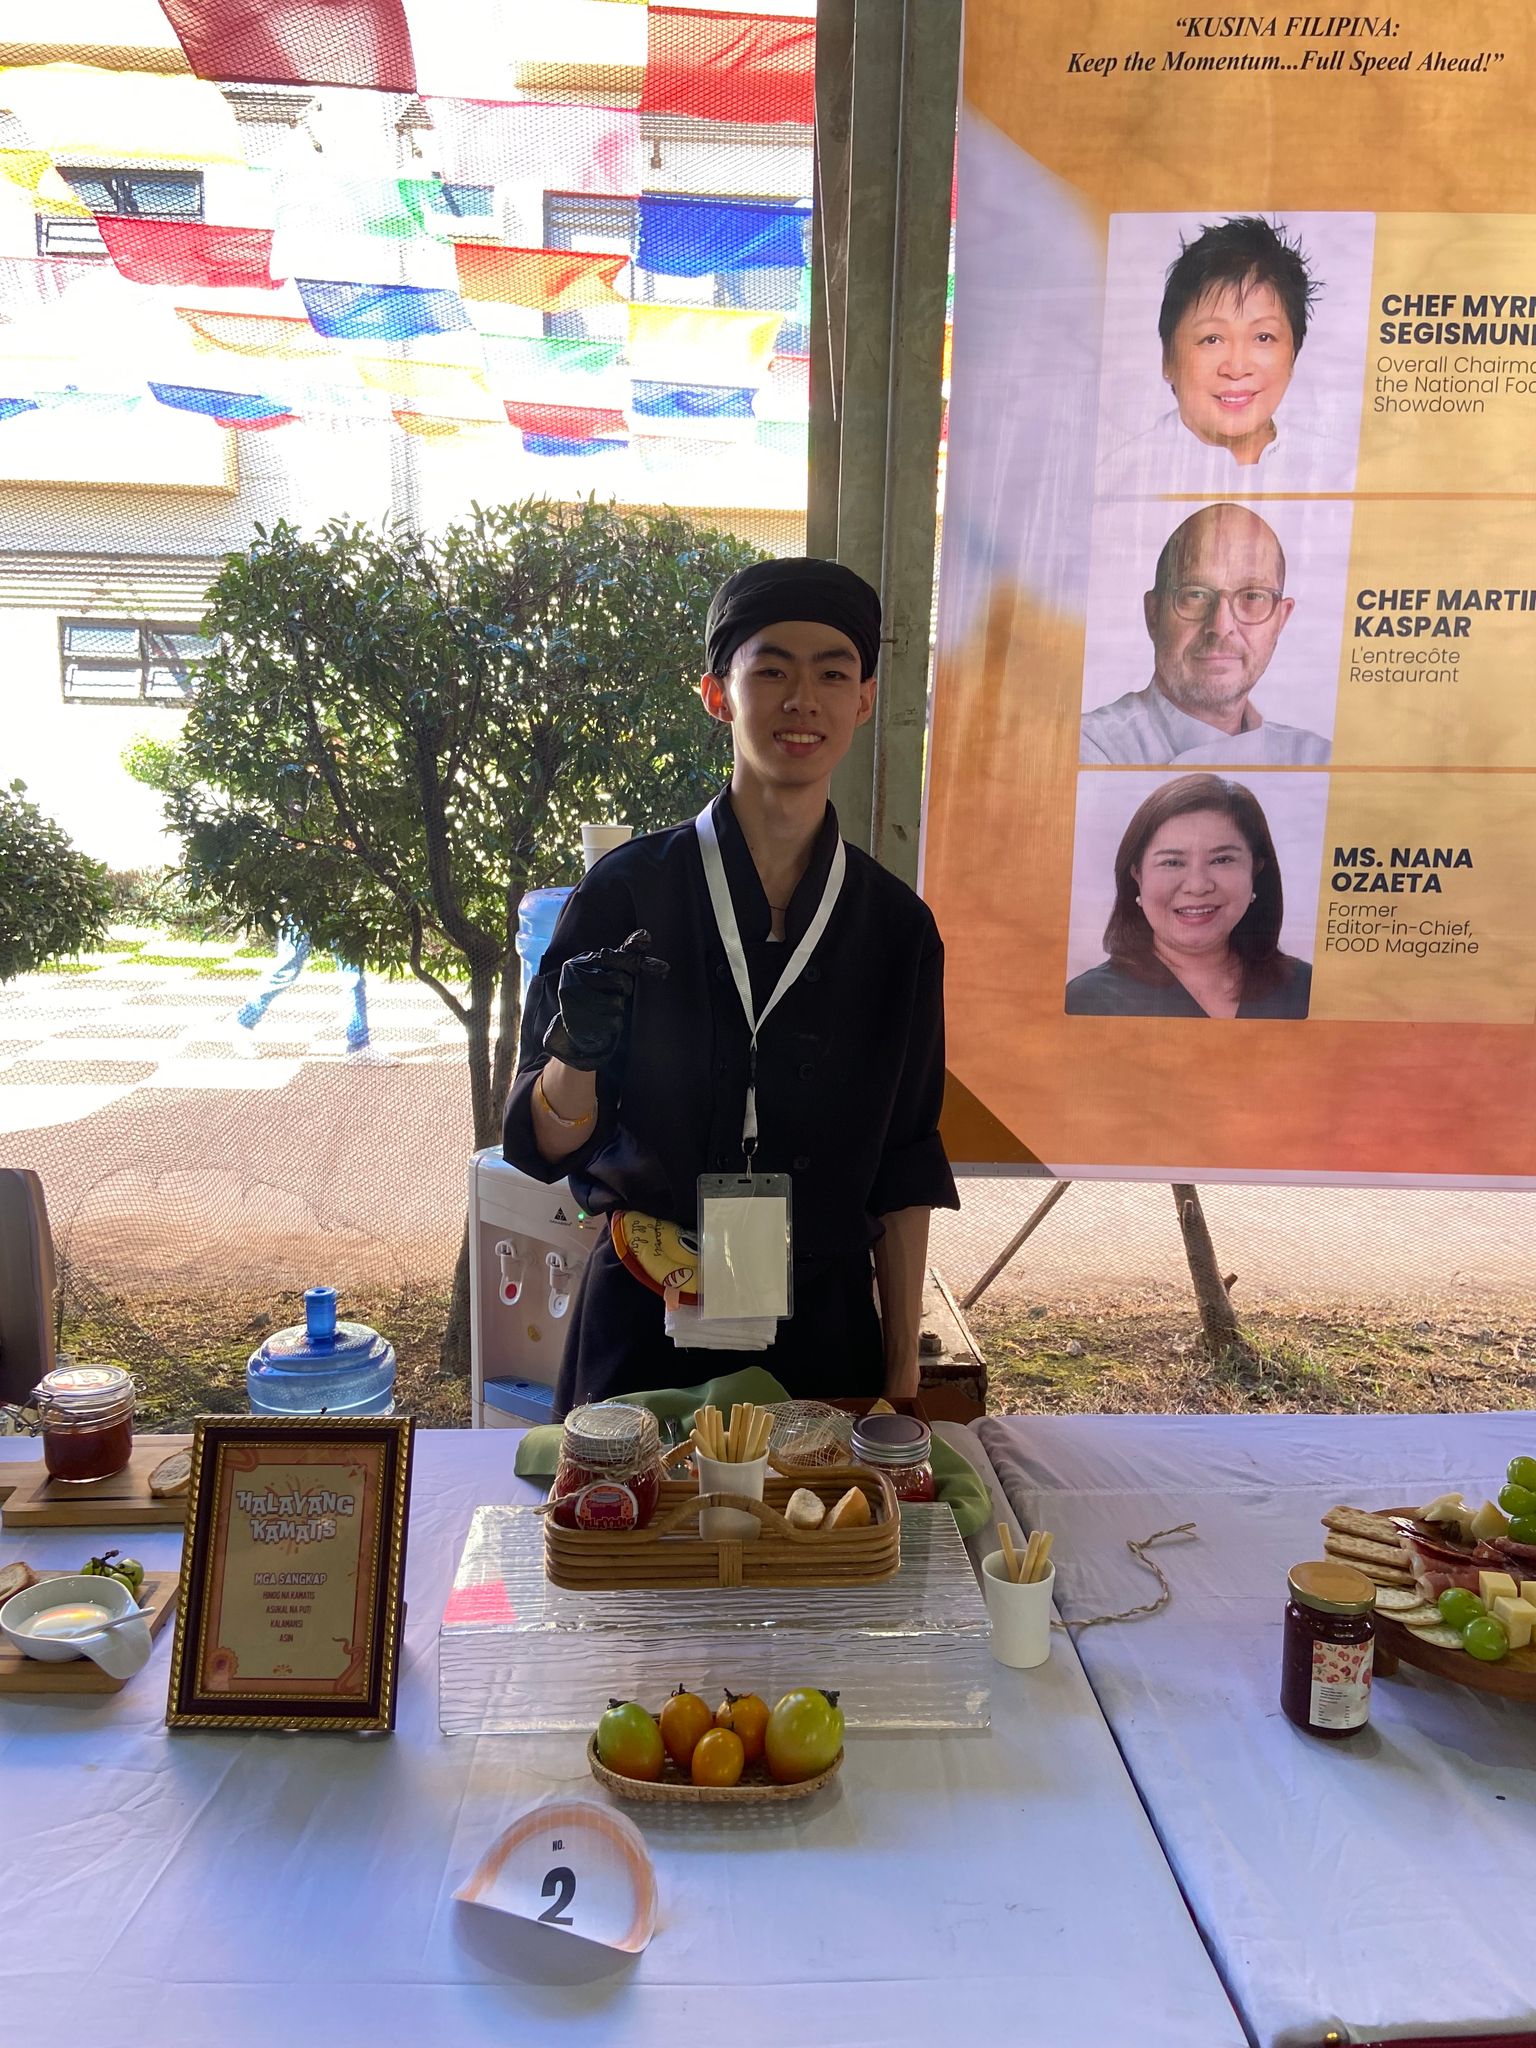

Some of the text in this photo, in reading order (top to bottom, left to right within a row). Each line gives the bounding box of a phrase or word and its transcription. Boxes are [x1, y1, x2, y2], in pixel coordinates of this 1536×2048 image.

[1176, 16, 1400, 38] “KUSINA FILIPINA:
[1066, 52, 1117, 77] Keep
[1123, 51, 1156, 72] the
[1349, 50, 1413, 77] Speed
[1416, 51, 1505, 73] Ahead!”
[1381, 294, 1457, 317] CHEF
[1379, 322, 1536, 346] SEGISMUN
[1377, 356, 1448, 374] Overall
[1375, 376, 1408, 393] the
[1414, 376, 1499, 394] National
[1373, 396, 1485, 413] Showdown
[1356, 589, 1431, 612] CHEF
[1354, 616, 1472, 638] KASPAR
[1351, 646, 1461, 665] L'entrecôte
[1350, 666, 1460, 683] Restaurant
[1333, 847, 1474, 869] MS. NANA
[1331, 872, 1443, 894] OZAETA
[1328, 902, 1399, 918] Former
[1327, 919, 1473, 939] Editor-in-Chief,
[1325, 937, 1479, 958] FOOD Magazine
[236, 1490, 355, 1517] HALAYANG
[250, 1519, 337, 1544] KAMATIS
[254, 1572, 328, 1586] MGA SANGKAP
[552, 1839, 565, 1852] NO.
[537, 1866, 577, 1926] 2
